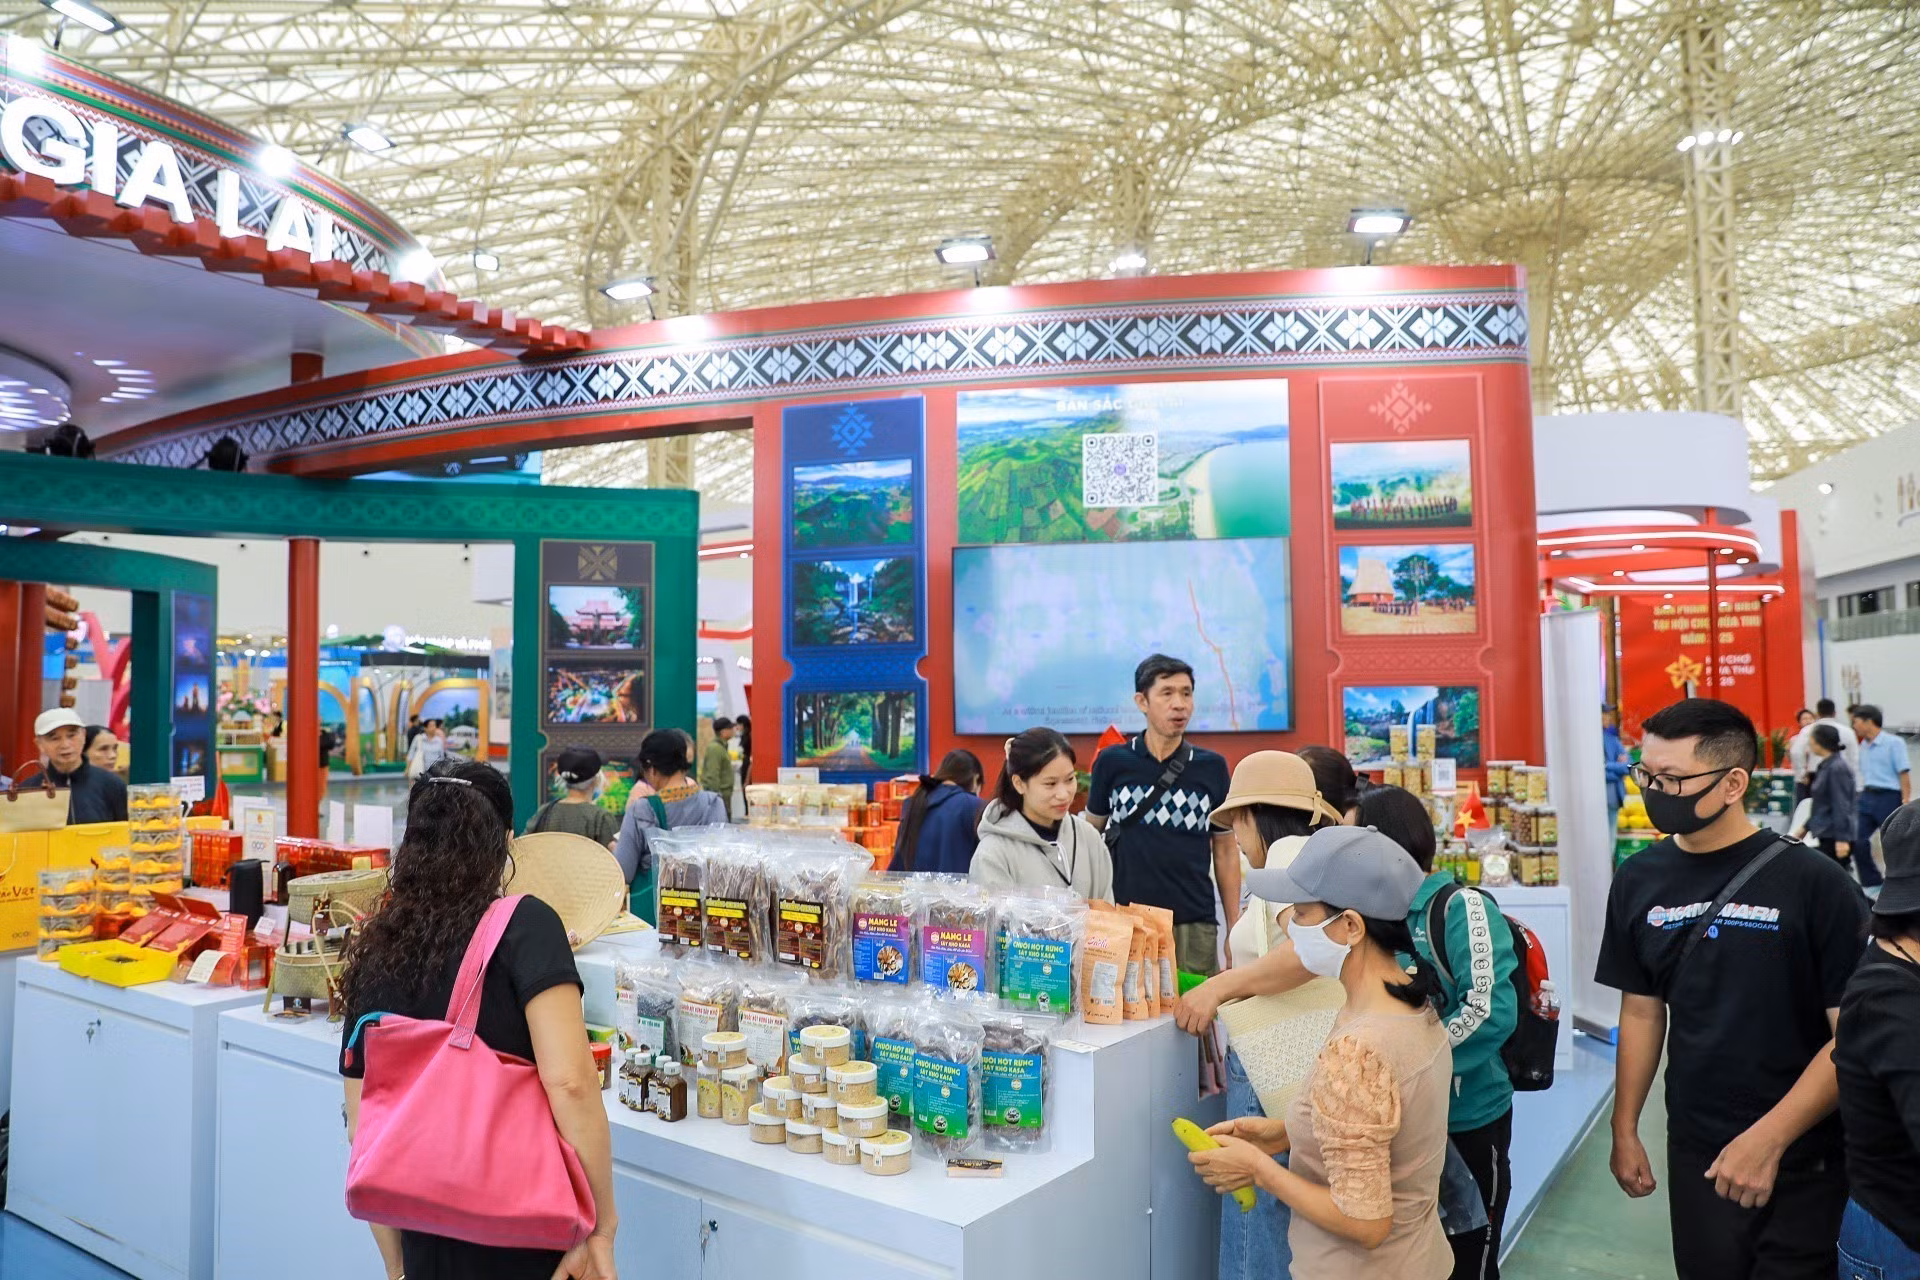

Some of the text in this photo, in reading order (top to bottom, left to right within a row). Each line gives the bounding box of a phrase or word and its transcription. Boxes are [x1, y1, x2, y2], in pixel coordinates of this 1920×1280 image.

[0, 96, 333, 263] GIA LAI
[1733, 665, 1756, 675] THU
[1669, 901, 1780, 922] KAMNARI
